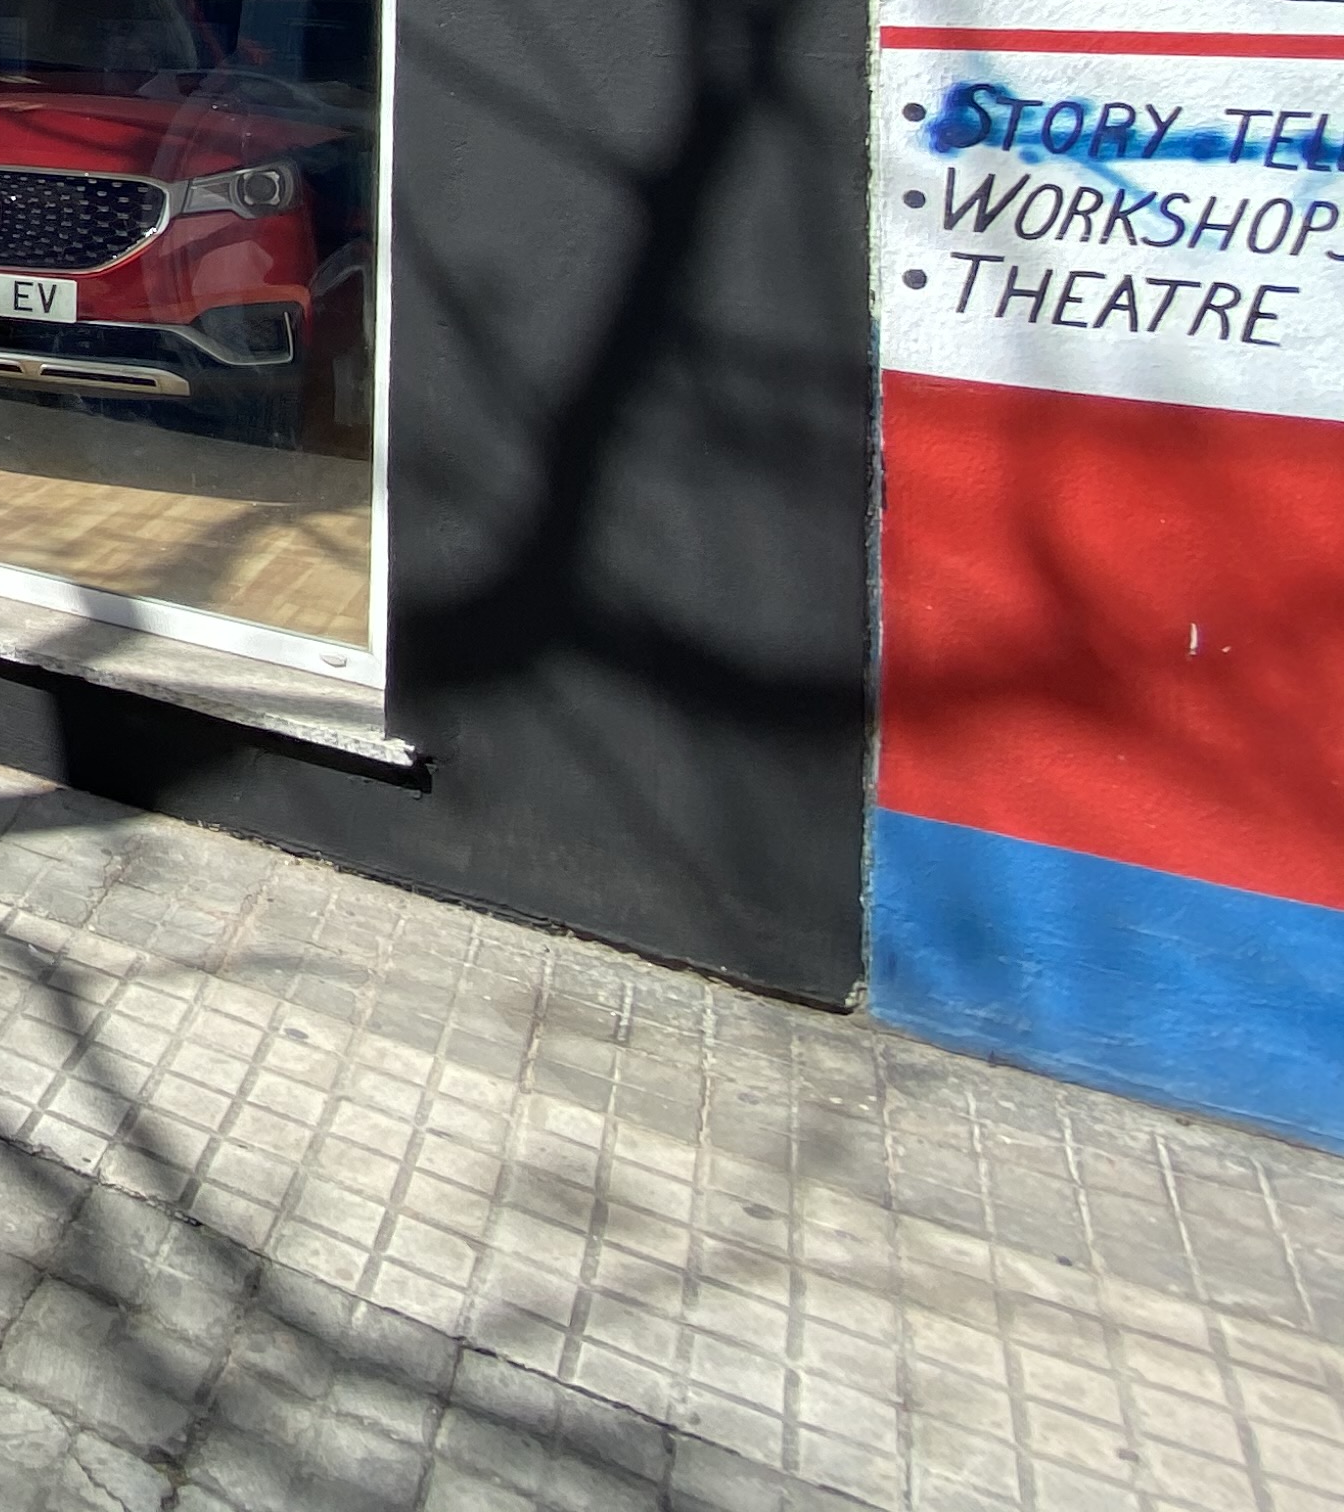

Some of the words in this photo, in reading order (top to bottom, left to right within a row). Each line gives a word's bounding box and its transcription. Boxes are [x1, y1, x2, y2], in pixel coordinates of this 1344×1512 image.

[939, 83, 1183, 160] STORY
[1225, 106, 1344, 173] TEL
[943, 166, 1344, 262] WORKSHOP
[14, 280, 57, 314] EV
[949, 251, 1301, 348] THEATRE
